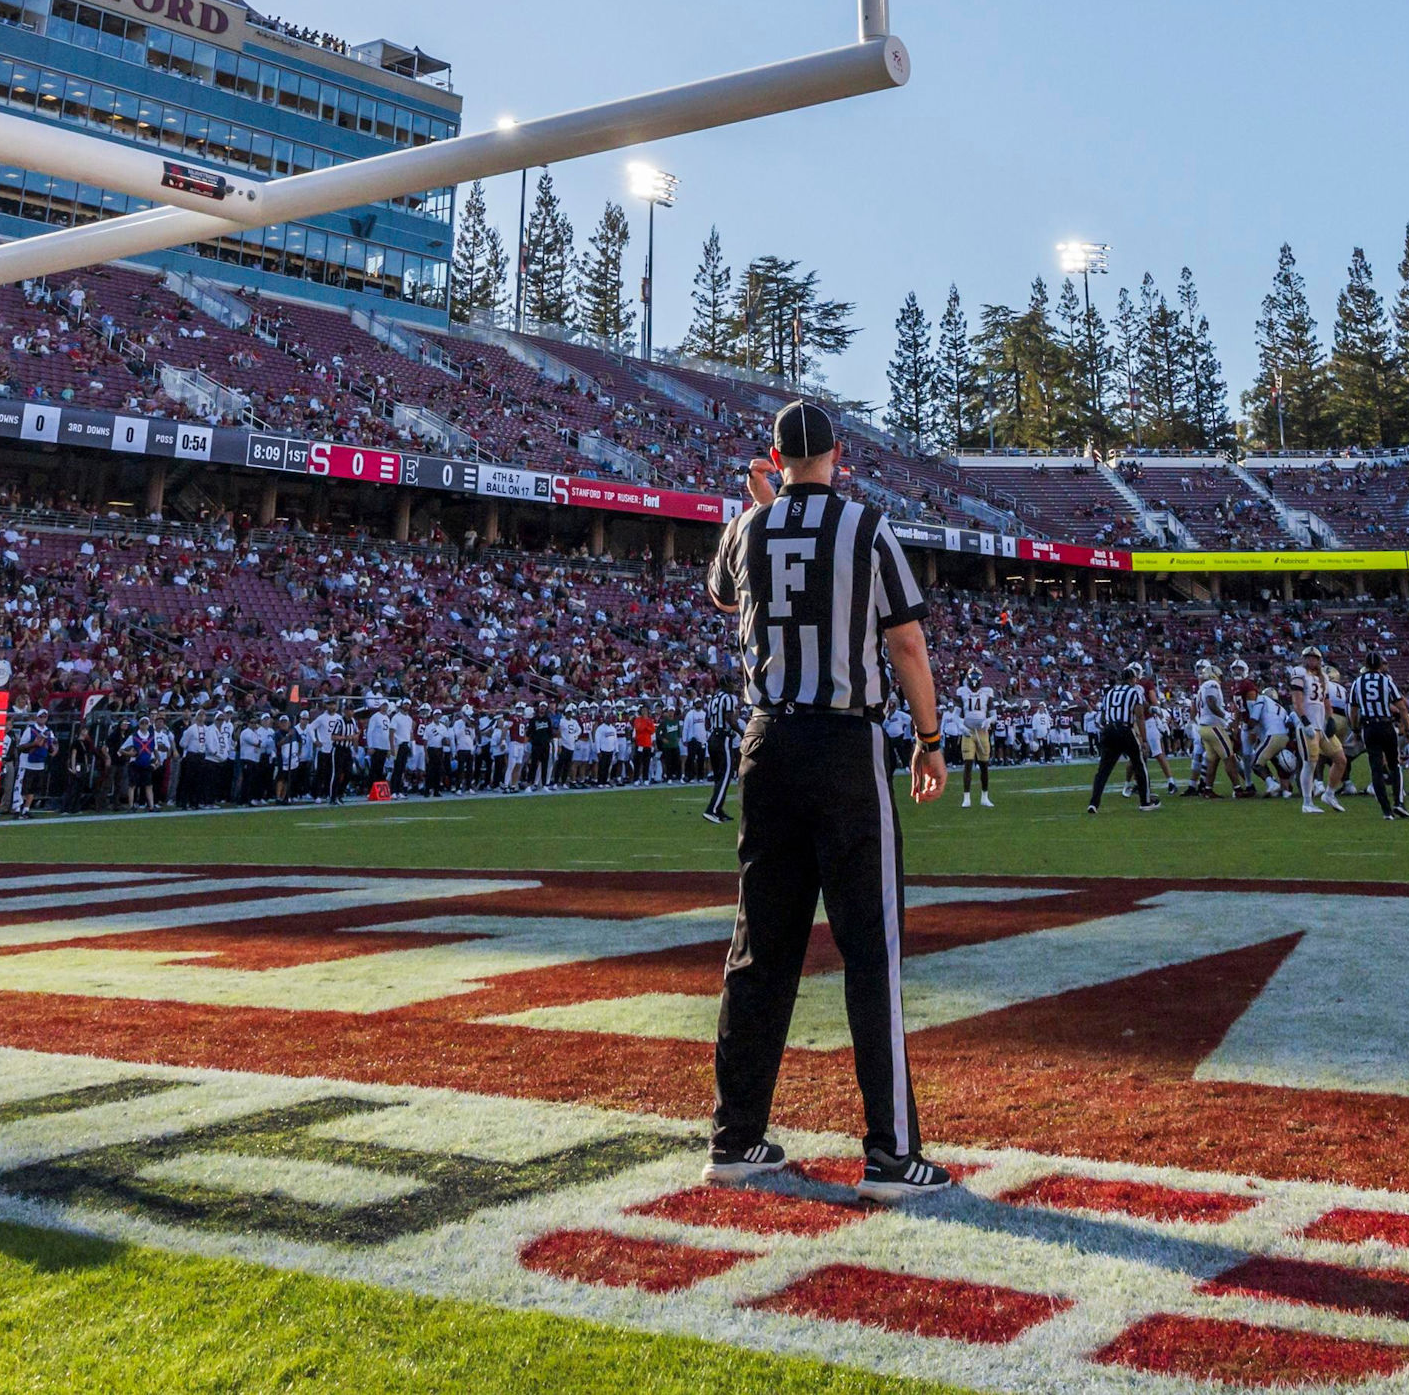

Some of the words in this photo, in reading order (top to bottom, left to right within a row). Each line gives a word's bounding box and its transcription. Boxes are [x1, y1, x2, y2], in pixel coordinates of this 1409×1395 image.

[35, 414, 46, 432] 0
[67, 422, 84, 434] 3RD
[86, 424, 110, 437] DOWNS
[125, 426, 135, 443] 0
[155, 433, 174, 445] POSS
[181, 433, 207, 453] 0:54
[253, 444, 281, 461] 8:09
[288, 449, 308, 463] 1ST
[309, 442, 331, 476] S
[352, 452, 364, 475] 0
[442, 464, 453, 486] 0
[492, 472, 508, 484] 4TH
[515, 474, 521, 484] 7
[486, 482, 508, 495] BALL
[508, 485, 521, 496] ON
[521, 486, 530, 497] 17
[537, 481, 547, 493] 25
[551, 475, 570, 504] S
[571, 485, 601, 500] STANFORD
[604, 490, 616, 501] TOP
[617, 492, 642, 505] RUSHER:
[643, 493, 660, 509] Ford
[696, 503, 719, 514] ATTEMPTS
[730, 506, 736, 518] 3
[766, 537, 817, 617] F
[1111, 690, 1126, 706] U
[1364, 680, 1380, 701] S
[967, 697, 981, 711] 14
